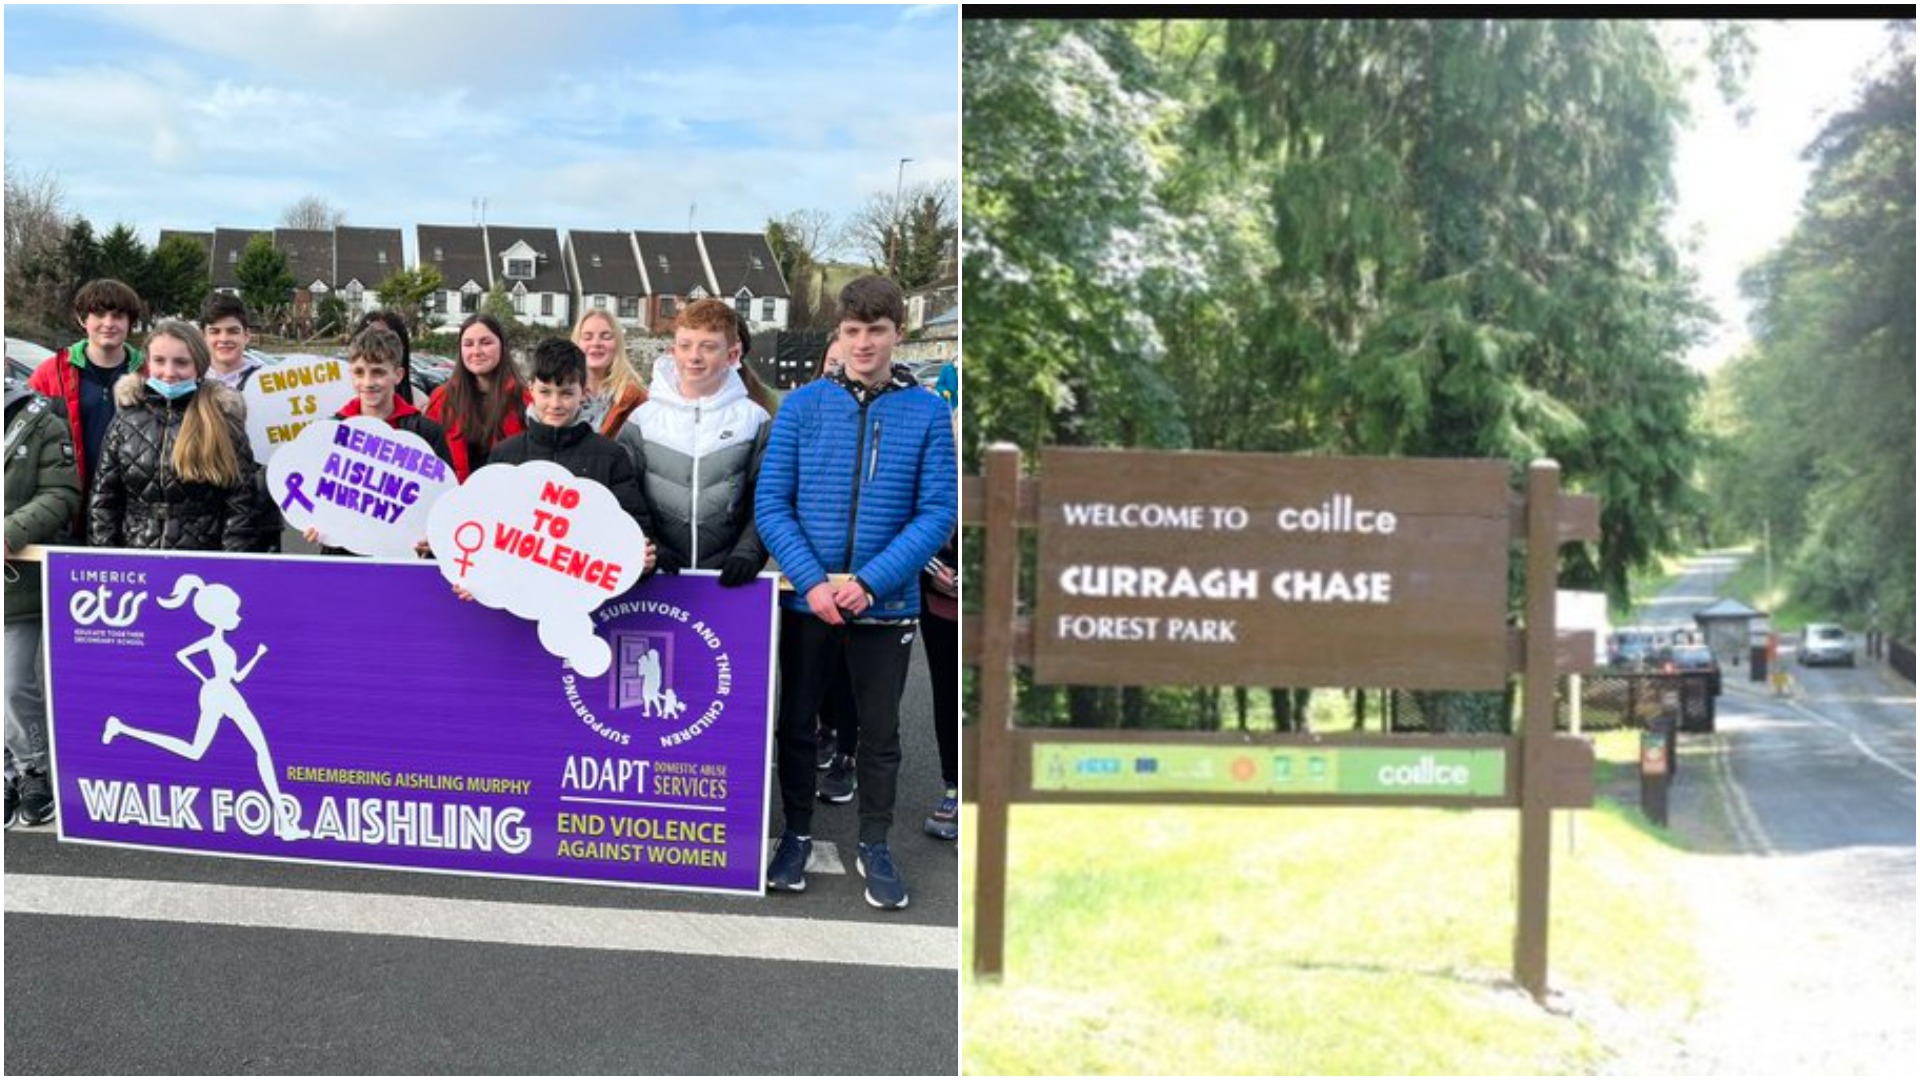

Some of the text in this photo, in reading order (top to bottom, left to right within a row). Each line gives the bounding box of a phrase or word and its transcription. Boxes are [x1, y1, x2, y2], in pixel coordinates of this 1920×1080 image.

[259, 360, 341, 393] ENOUGH
[288, 394, 317, 416] IS
[266, 421, 313, 444] ENO
[333, 424, 446, 482] REMEMBER
[323, 452, 420, 505] AISLING
[315, 476, 405, 524] MURPHY
[540, 480, 581, 510] NO
[533, 509, 570, 538] TO
[1063, 503, 1204, 529] WELCOME
[1211, 506, 1249, 529] TO
[493, 522, 622, 591] VIOLENCE
[71, 569, 147, 584] LIMERICK
[1059, 565, 1391, 602] CURRAGH CHASE
[1058, 616, 1238, 643] FOREST PARK
[600, 601, 732, 747] SURVIVORS AND THEIR CHILDREN
[562, 674, 631, 745] SUPPORTING
[286, 766, 532, 795] REMEMBERING AISHLING MURPHY
[561, 755, 650, 793] ADAPT
[654, 761, 727, 776] DOMESTIC ABUSE
[654, 775, 728, 799] SERVICES
[78, 777, 532, 854] WALK FOR AISHLING
[557, 812, 726, 844] END VIOLENCE
[557, 840, 727, 868] AGAINST WOMEN
